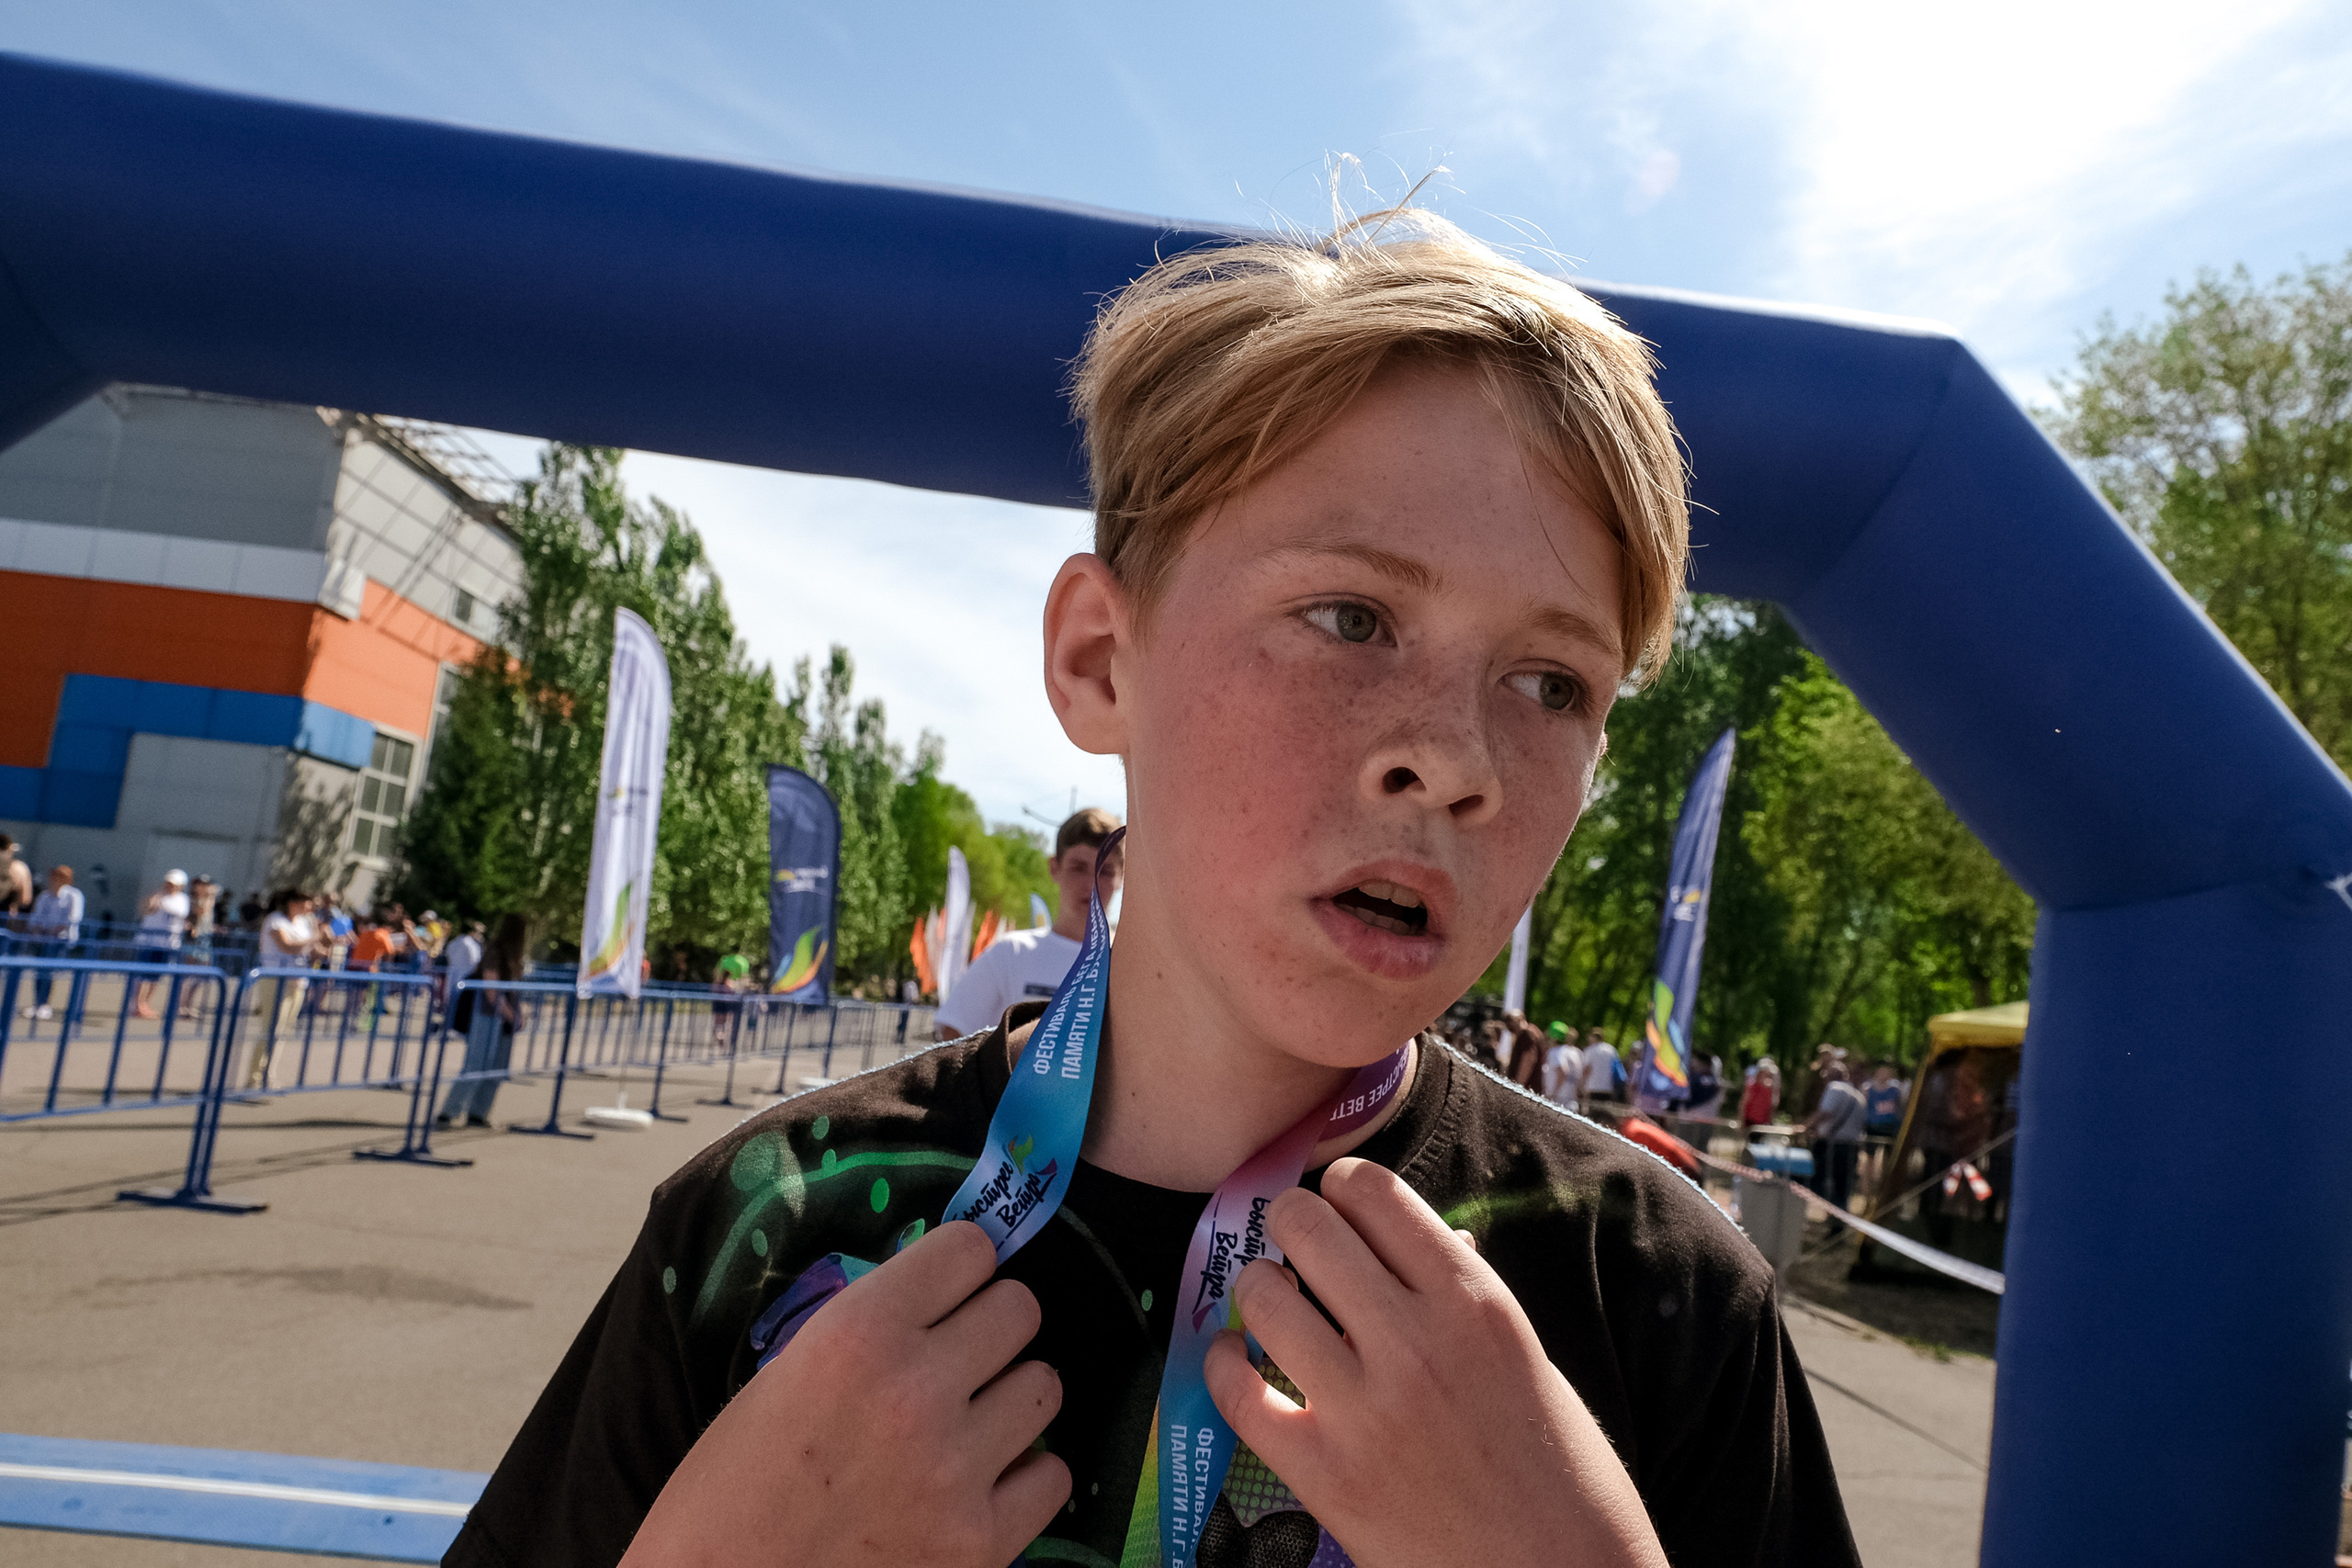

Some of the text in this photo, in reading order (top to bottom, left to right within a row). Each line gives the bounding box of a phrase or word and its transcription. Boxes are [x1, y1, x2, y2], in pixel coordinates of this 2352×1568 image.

[1033, 986, 1077, 1075] ФЕСТИВАЛЬ
[1071, 950, 1095, 986] БЕГА
[1061, 1011, 1091, 1079] ПАМЯТИ
[952, 1161, 1014, 1222] ыстрее
[995, 1172, 1044, 1228] Ветра
[1201, 1231, 1238, 1300] Ветра
[1234, 1197, 1272, 1267] Быстр
[1170, 1425, 1189, 1512] ПАМЯТИ
